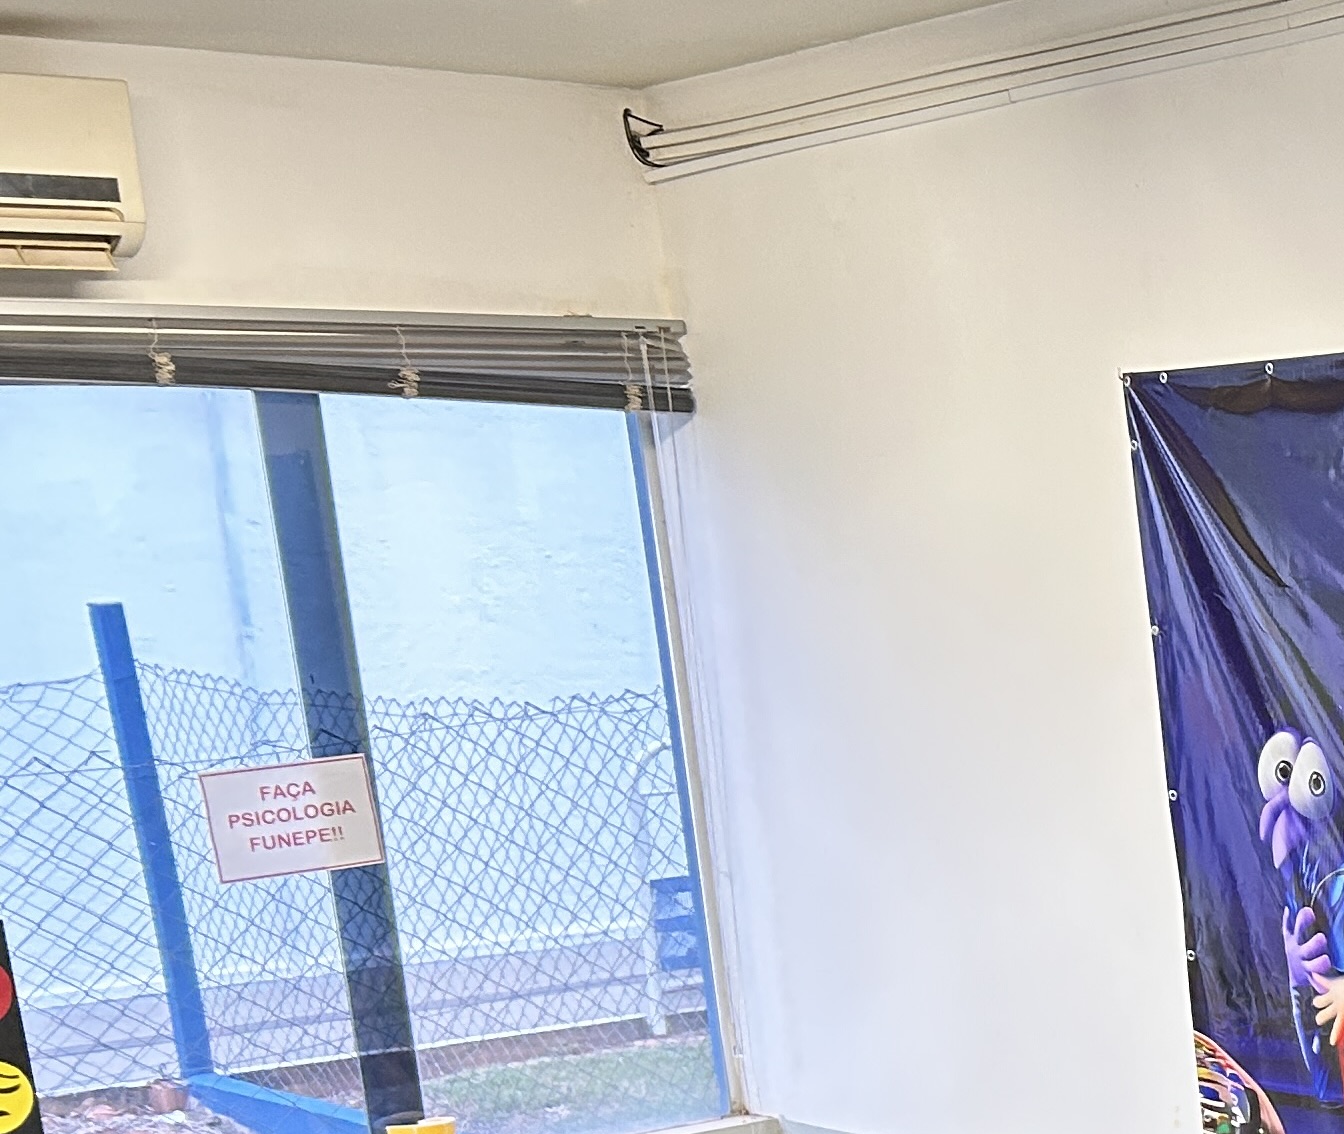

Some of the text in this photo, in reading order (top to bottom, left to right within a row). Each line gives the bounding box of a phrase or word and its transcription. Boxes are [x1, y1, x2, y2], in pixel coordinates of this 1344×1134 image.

[259, 781, 316, 801] FAÇA
[228, 800, 357, 829] PSICOLOGIA
[250, 826, 345, 852] FUNEPE!!
